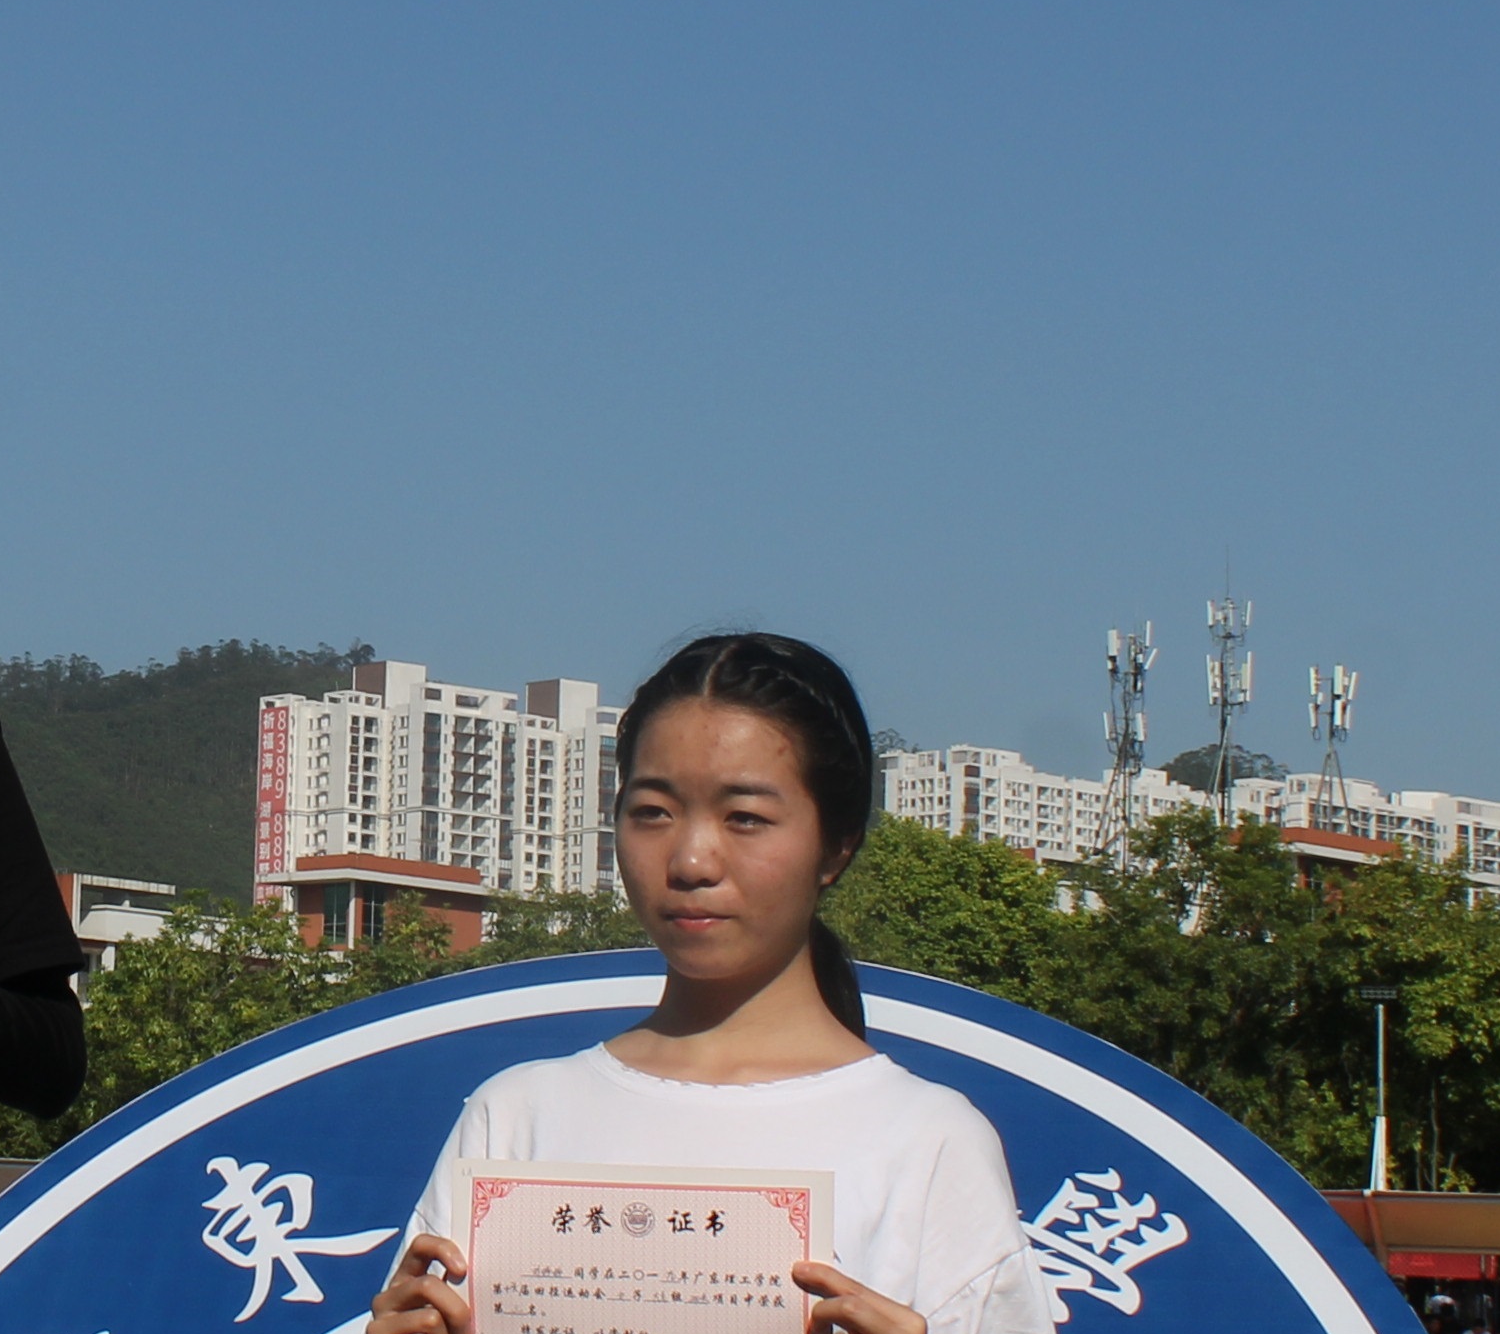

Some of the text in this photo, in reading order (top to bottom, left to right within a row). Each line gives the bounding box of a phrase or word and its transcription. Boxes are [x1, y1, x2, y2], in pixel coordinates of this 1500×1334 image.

[275, 710, 286, 799] 8389
[551, 1203, 727, 1237] 荣誉 证书
